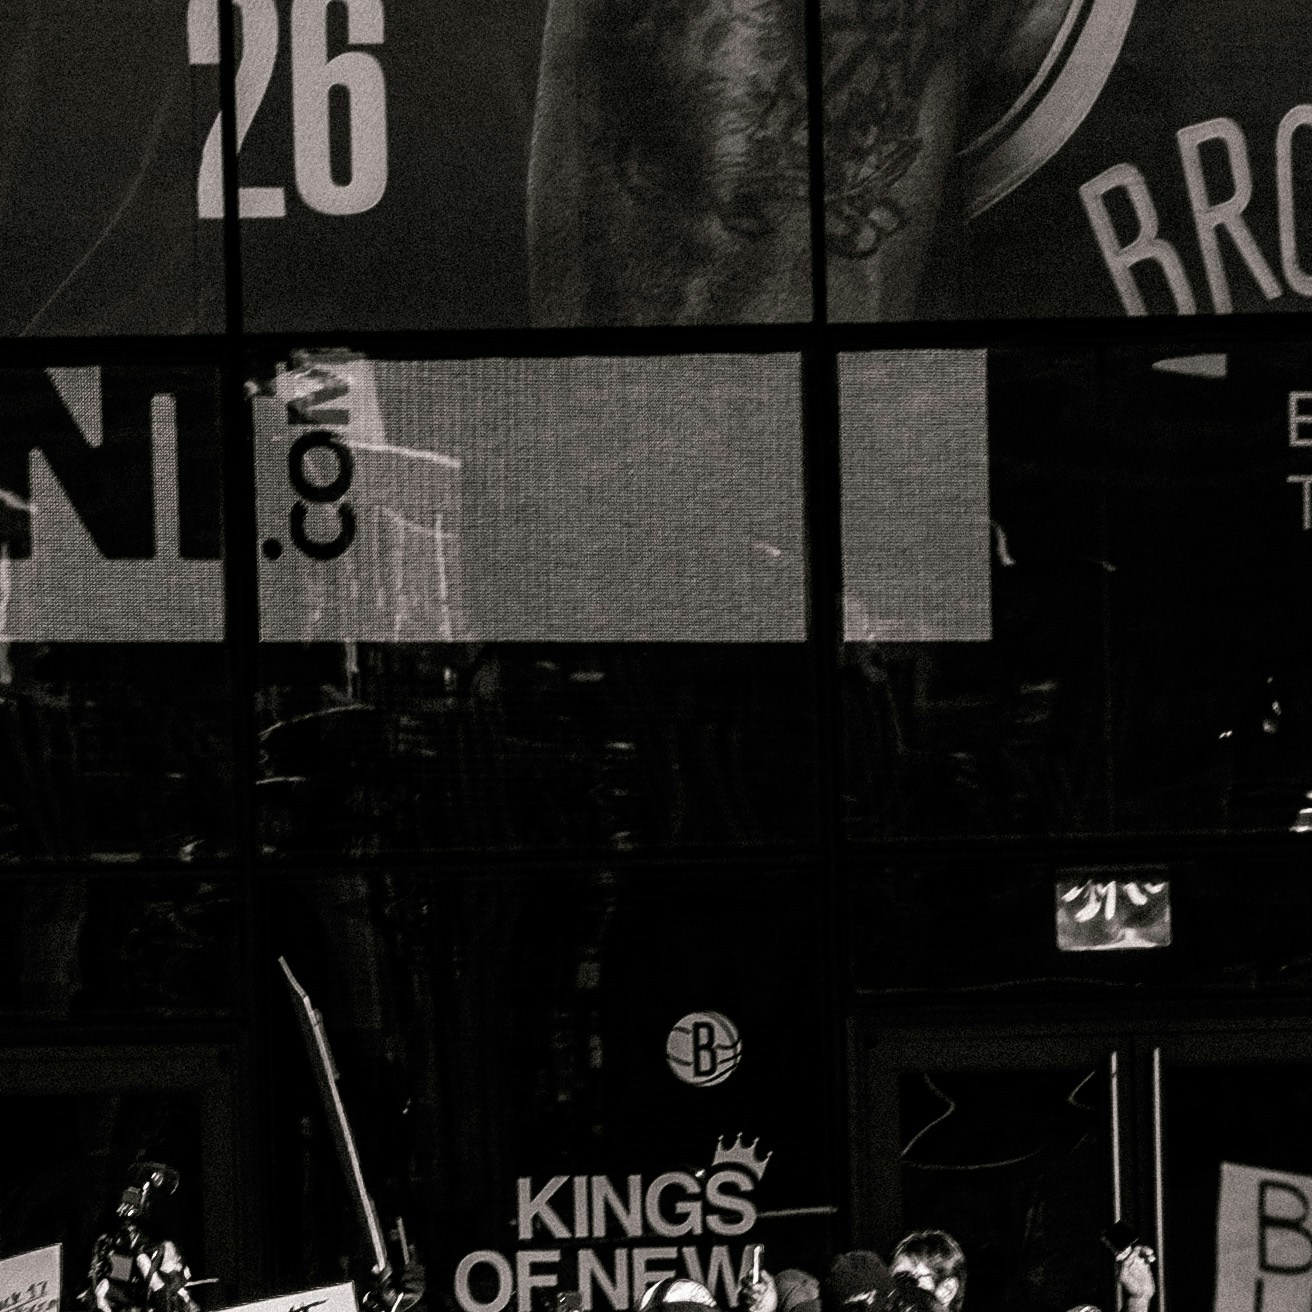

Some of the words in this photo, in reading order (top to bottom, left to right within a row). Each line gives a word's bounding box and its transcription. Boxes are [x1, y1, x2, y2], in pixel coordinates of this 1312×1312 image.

[186, 0, 390, 219] 26
[516, 1168, 758, 1241] KINGS
[577, 1244, 758, 1312] NEW
